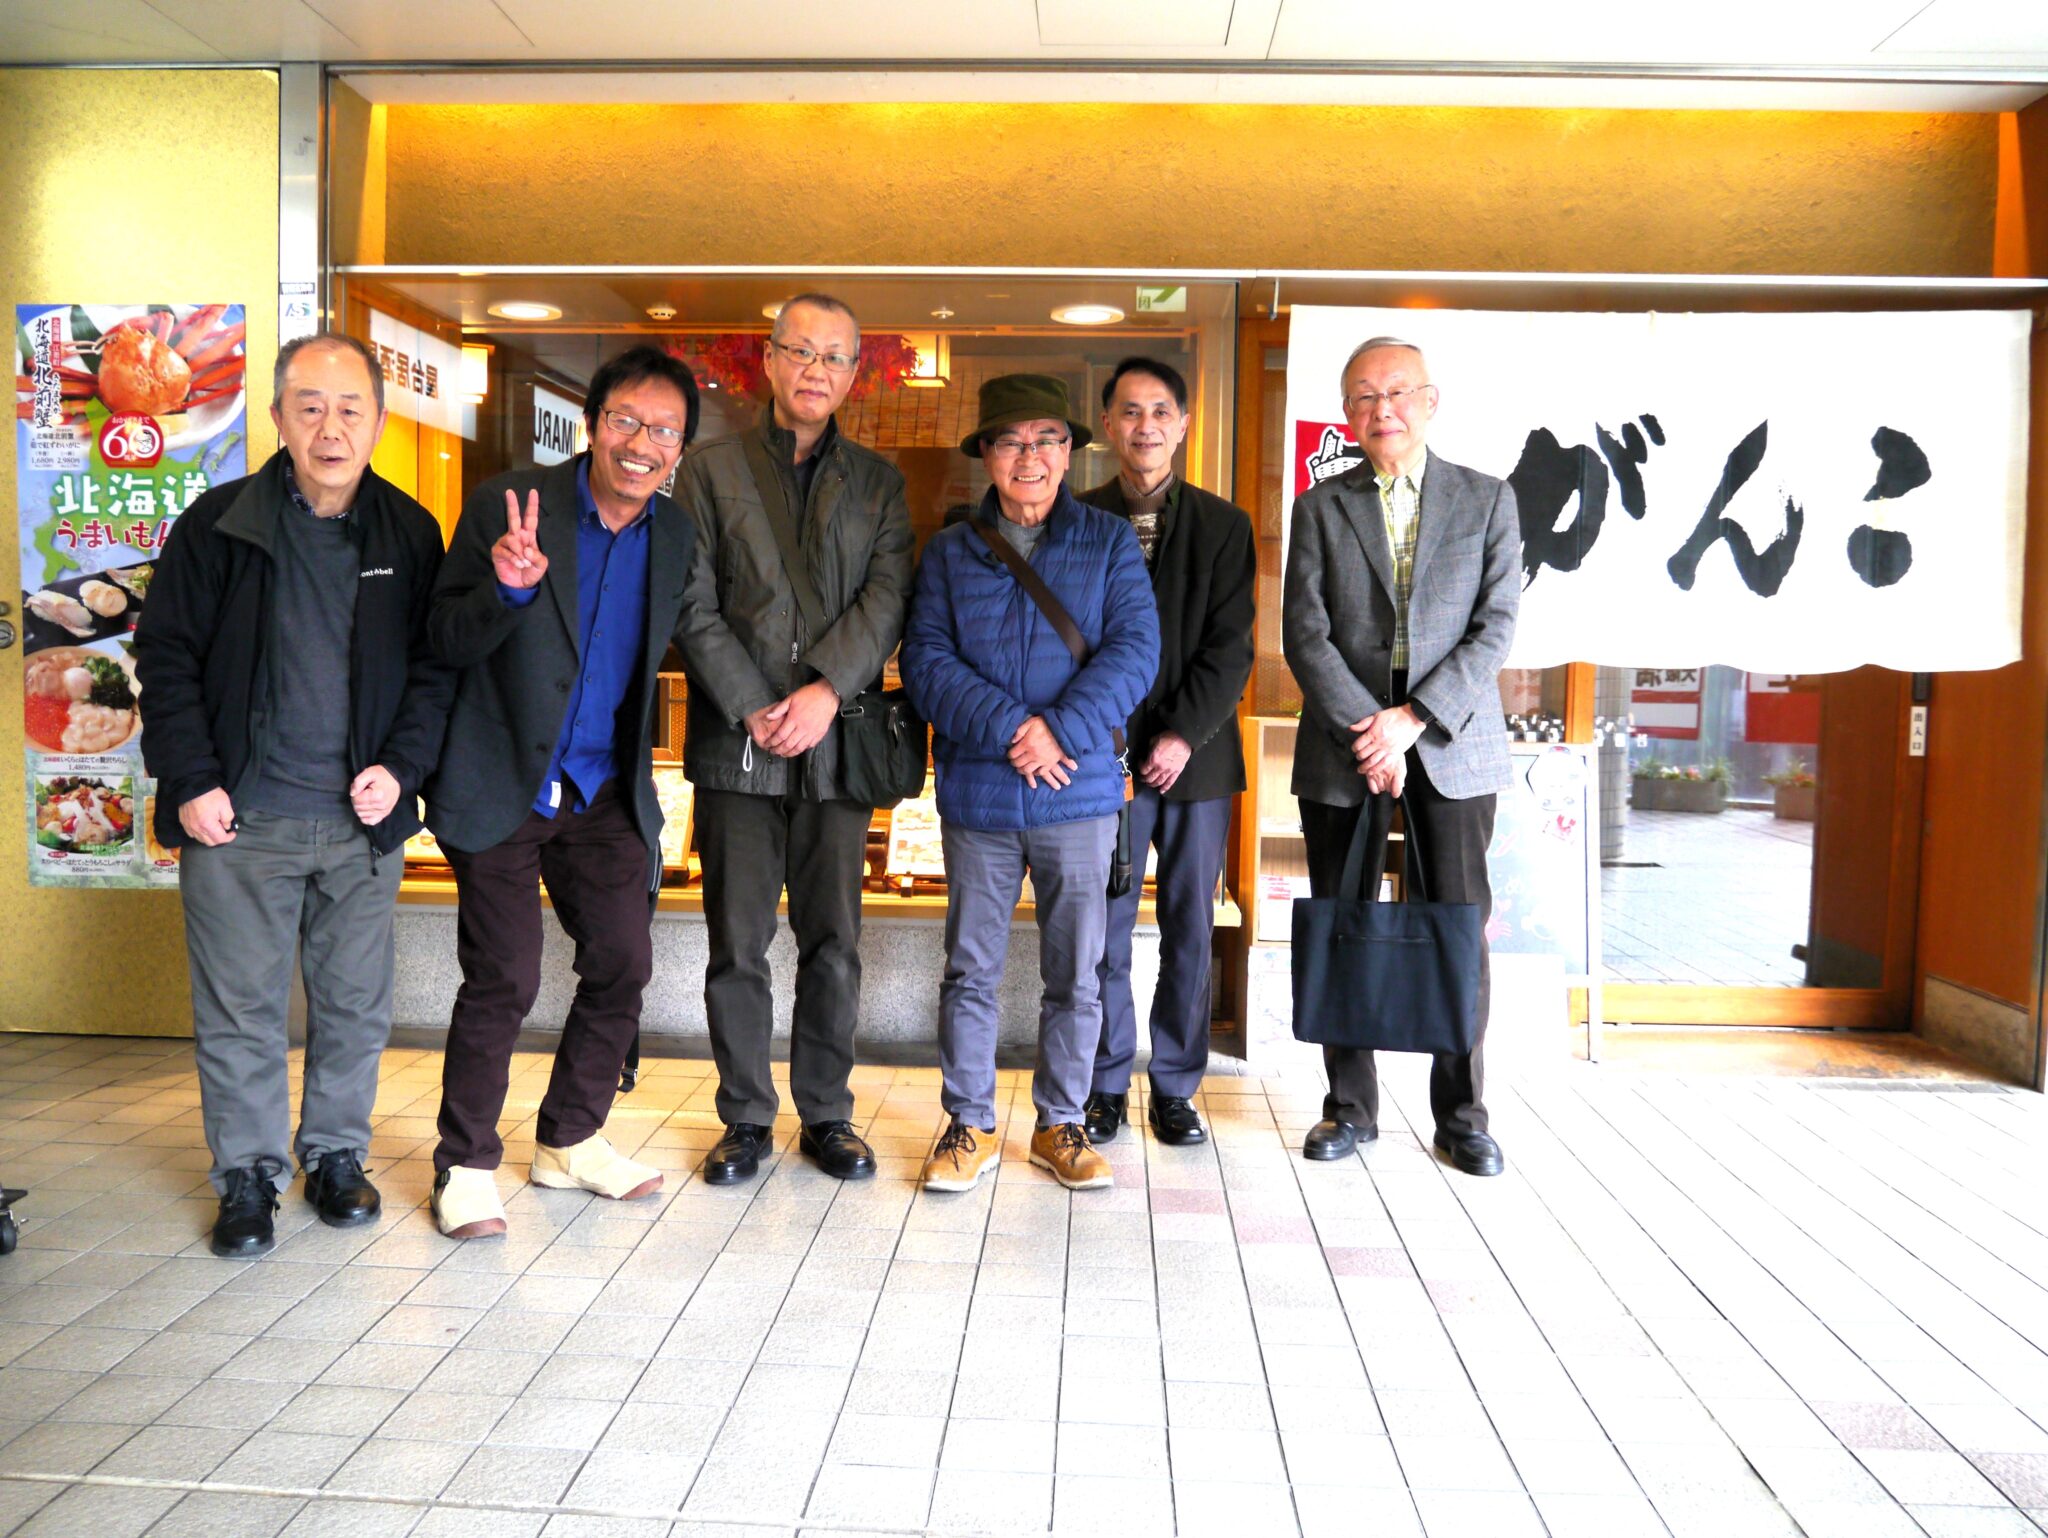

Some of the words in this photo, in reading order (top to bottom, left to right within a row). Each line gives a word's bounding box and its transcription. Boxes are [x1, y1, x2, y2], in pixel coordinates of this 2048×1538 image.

[103, 424, 160, 459] 60
[54, 471, 209, 517] 北海道
[1507, 413, 1932, 599] がんこ
[1912, 712, 1923, 750] 出入口
